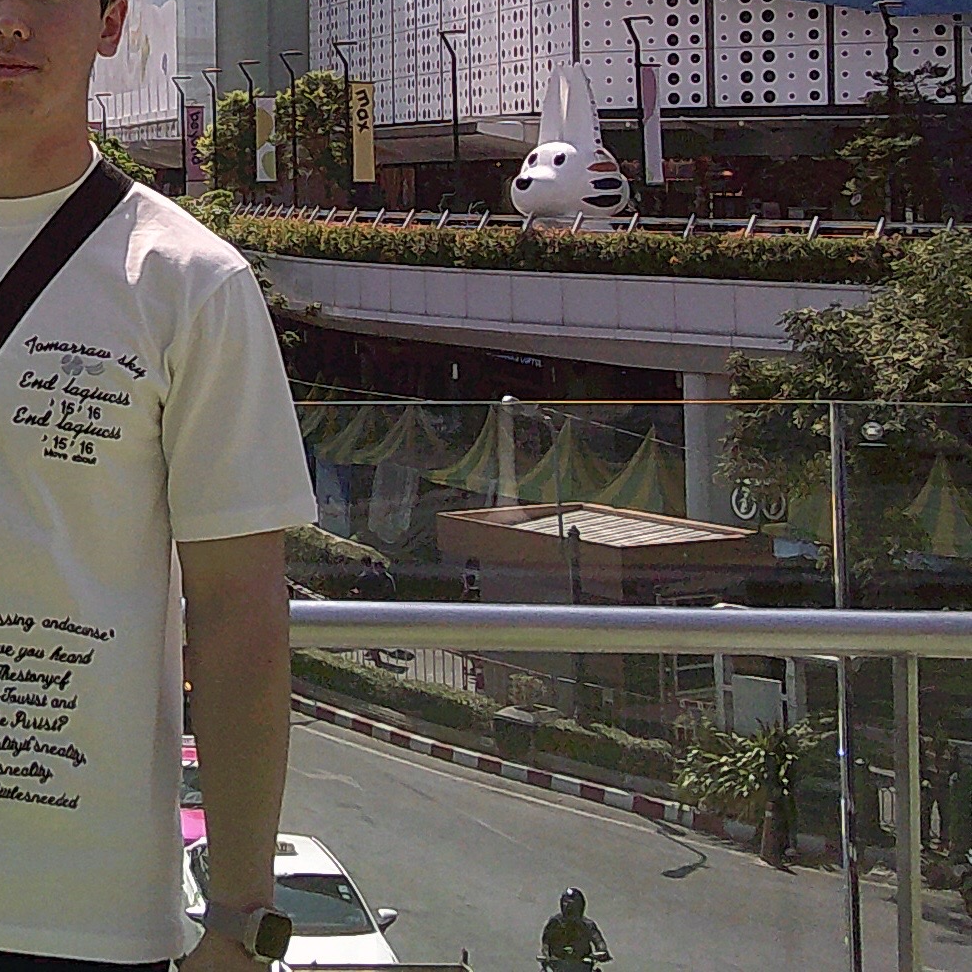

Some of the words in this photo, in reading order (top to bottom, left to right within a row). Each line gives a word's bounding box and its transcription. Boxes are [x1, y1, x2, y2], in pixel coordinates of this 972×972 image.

[354, 87, 370, 134] max
[117, 354, 148, 380] sky
[18, 371, 59, 391] End
[12, 406, 53, 427] End
[15, 645, 45, 662] you
[51, 695, 78, 710] and
